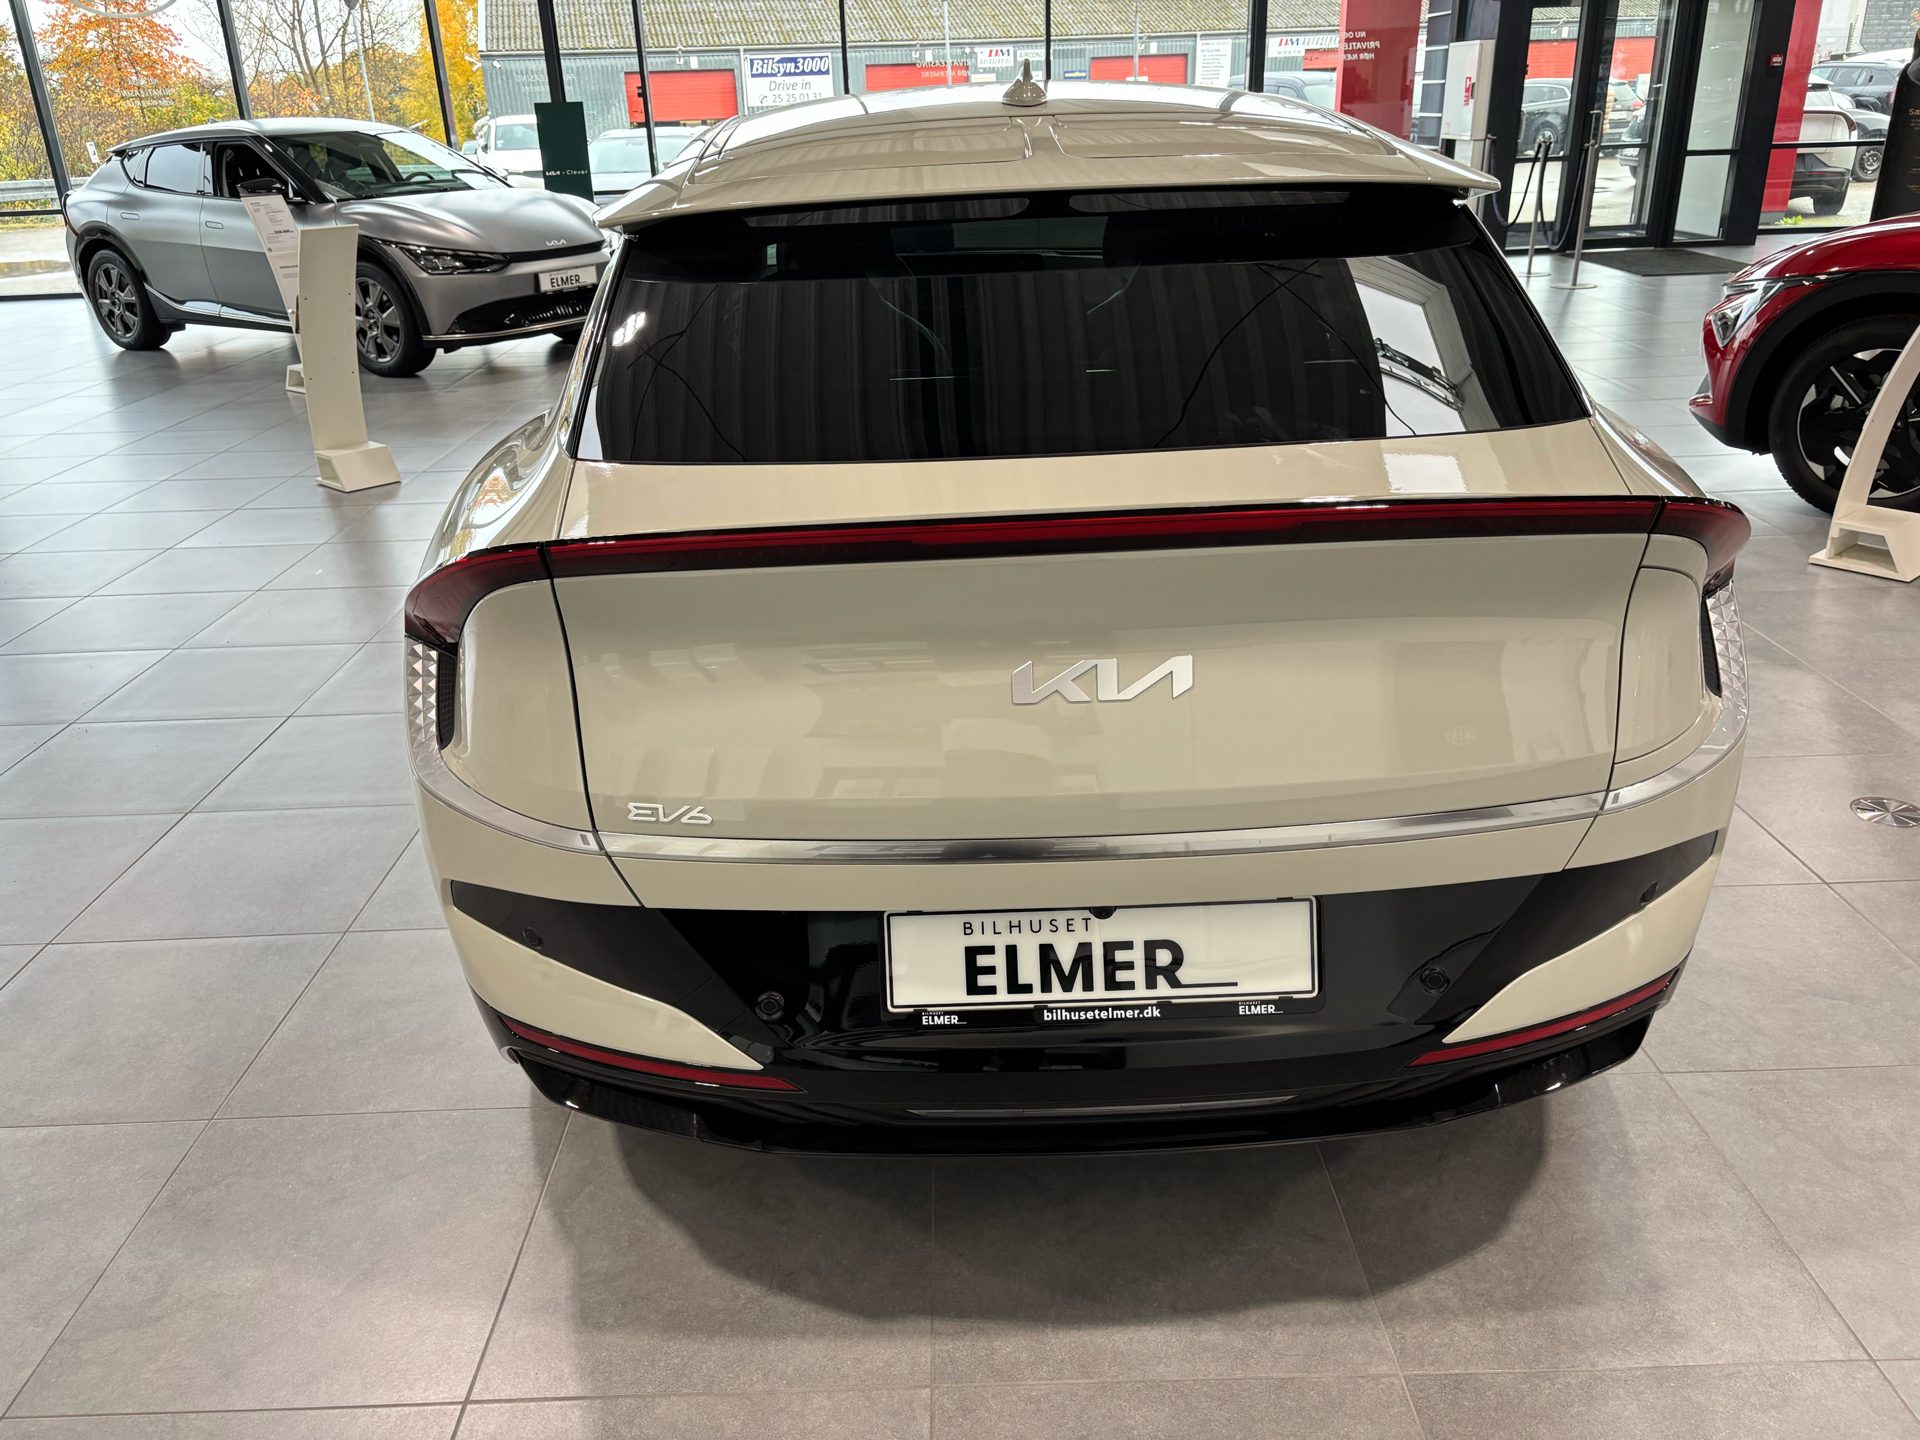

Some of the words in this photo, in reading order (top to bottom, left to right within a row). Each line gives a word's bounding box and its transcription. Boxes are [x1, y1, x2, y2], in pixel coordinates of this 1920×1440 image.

[988, 49, 1011, 57] DM
[751, 57, 829, 77] Bilsyn3000
[768, 79, 798, 92] Drive
[800, 78, 812, 91] in
[771, 94, 784, 104] 25
[786, 93, 797, 103] 25
[550, 273, 587, 288] ELMER
[1012, 655, 1193, 704] KIA
[627, 802, 713, 824] EV6
[963, 918, 1091, 936] BILHUSET
[964, 939, 1238, 996] ELMER
[1043, 1006, 1161, 1022] bilhusetelmer.dk
[1238, 1004, 1284, 1015] ELMER
[922, 1015, 967, 1025] ELMER
